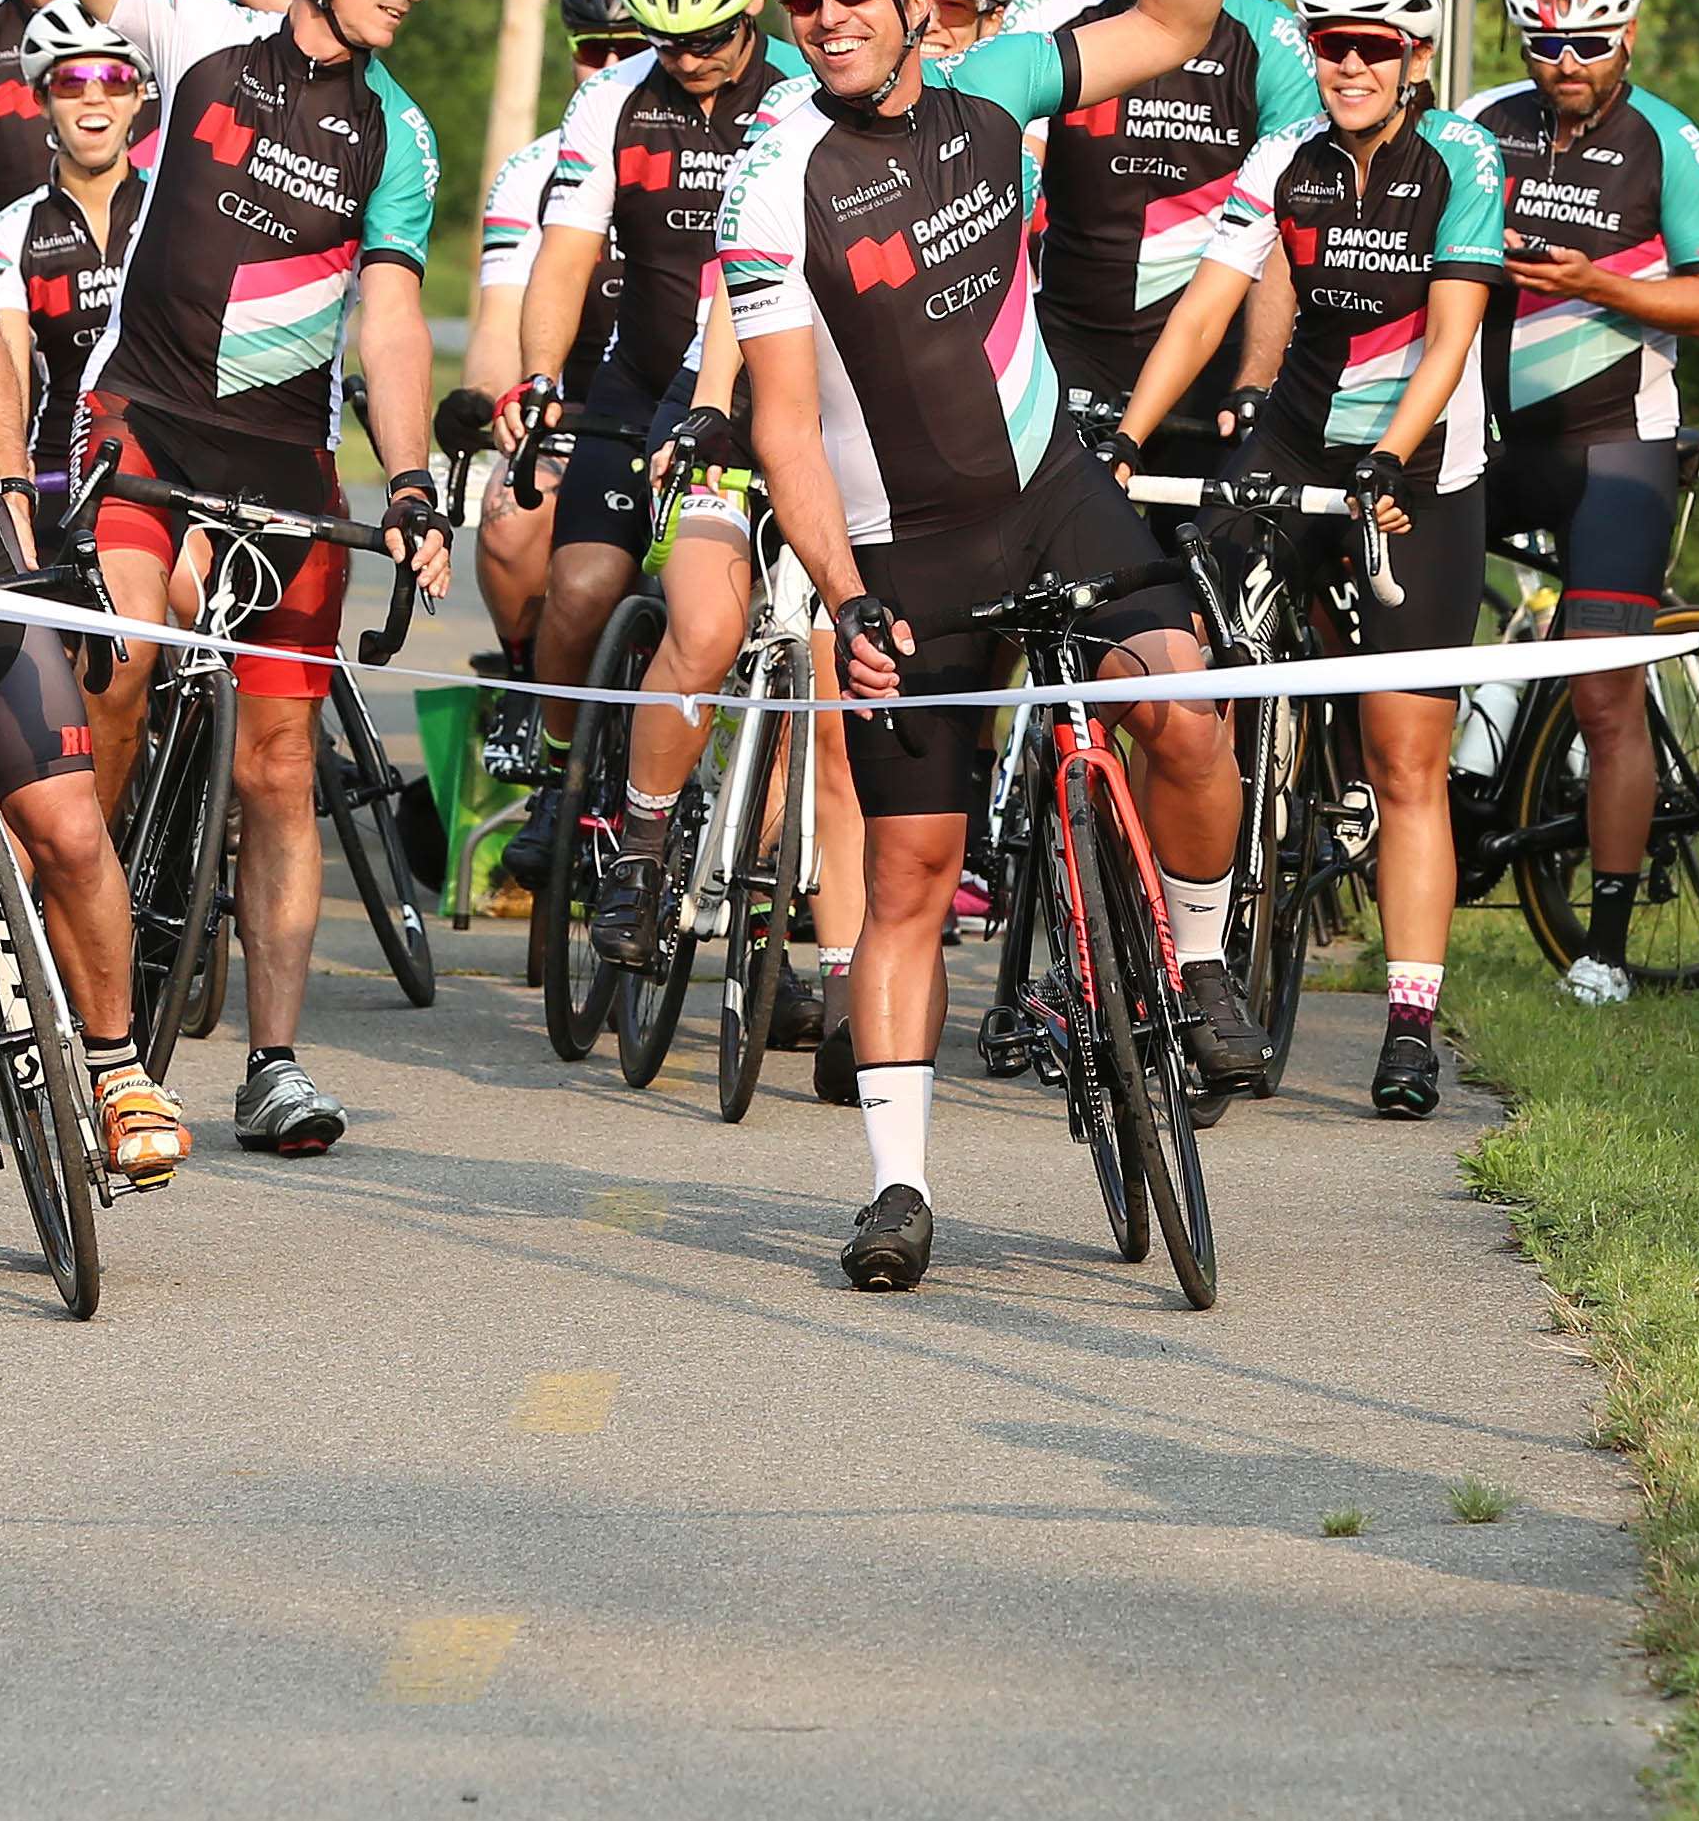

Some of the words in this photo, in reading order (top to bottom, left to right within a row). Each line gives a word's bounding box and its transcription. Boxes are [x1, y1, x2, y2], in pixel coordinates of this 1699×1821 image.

[1126, 97, 1213, 124] BANQUE
[1125, 121, 1241, 149] NATIONALE
[255, 137, 341, 189] BANQUE
[1109, 155, 1189, 181] CEZinc
[247, 157, 359, 219] NATIONALE
[831, 175, 899, 213] fondation
[1520, 178, 1601, 208] BANQUE
[217, 191, 299, 244] CEZinc
[911, 179, 995, 245] BANQUE
[921, 183, 1018, 269] NATIONALE
[1514, 196, 1621, 231] NATIONALE
[1326, 227, 1409, 251] BANQUE
[1324, 249, 1434, 273] NATIONALE
[924, 266, 1002, 321] CEZinc
[1310, 287, 1385, 314] CEZinc
